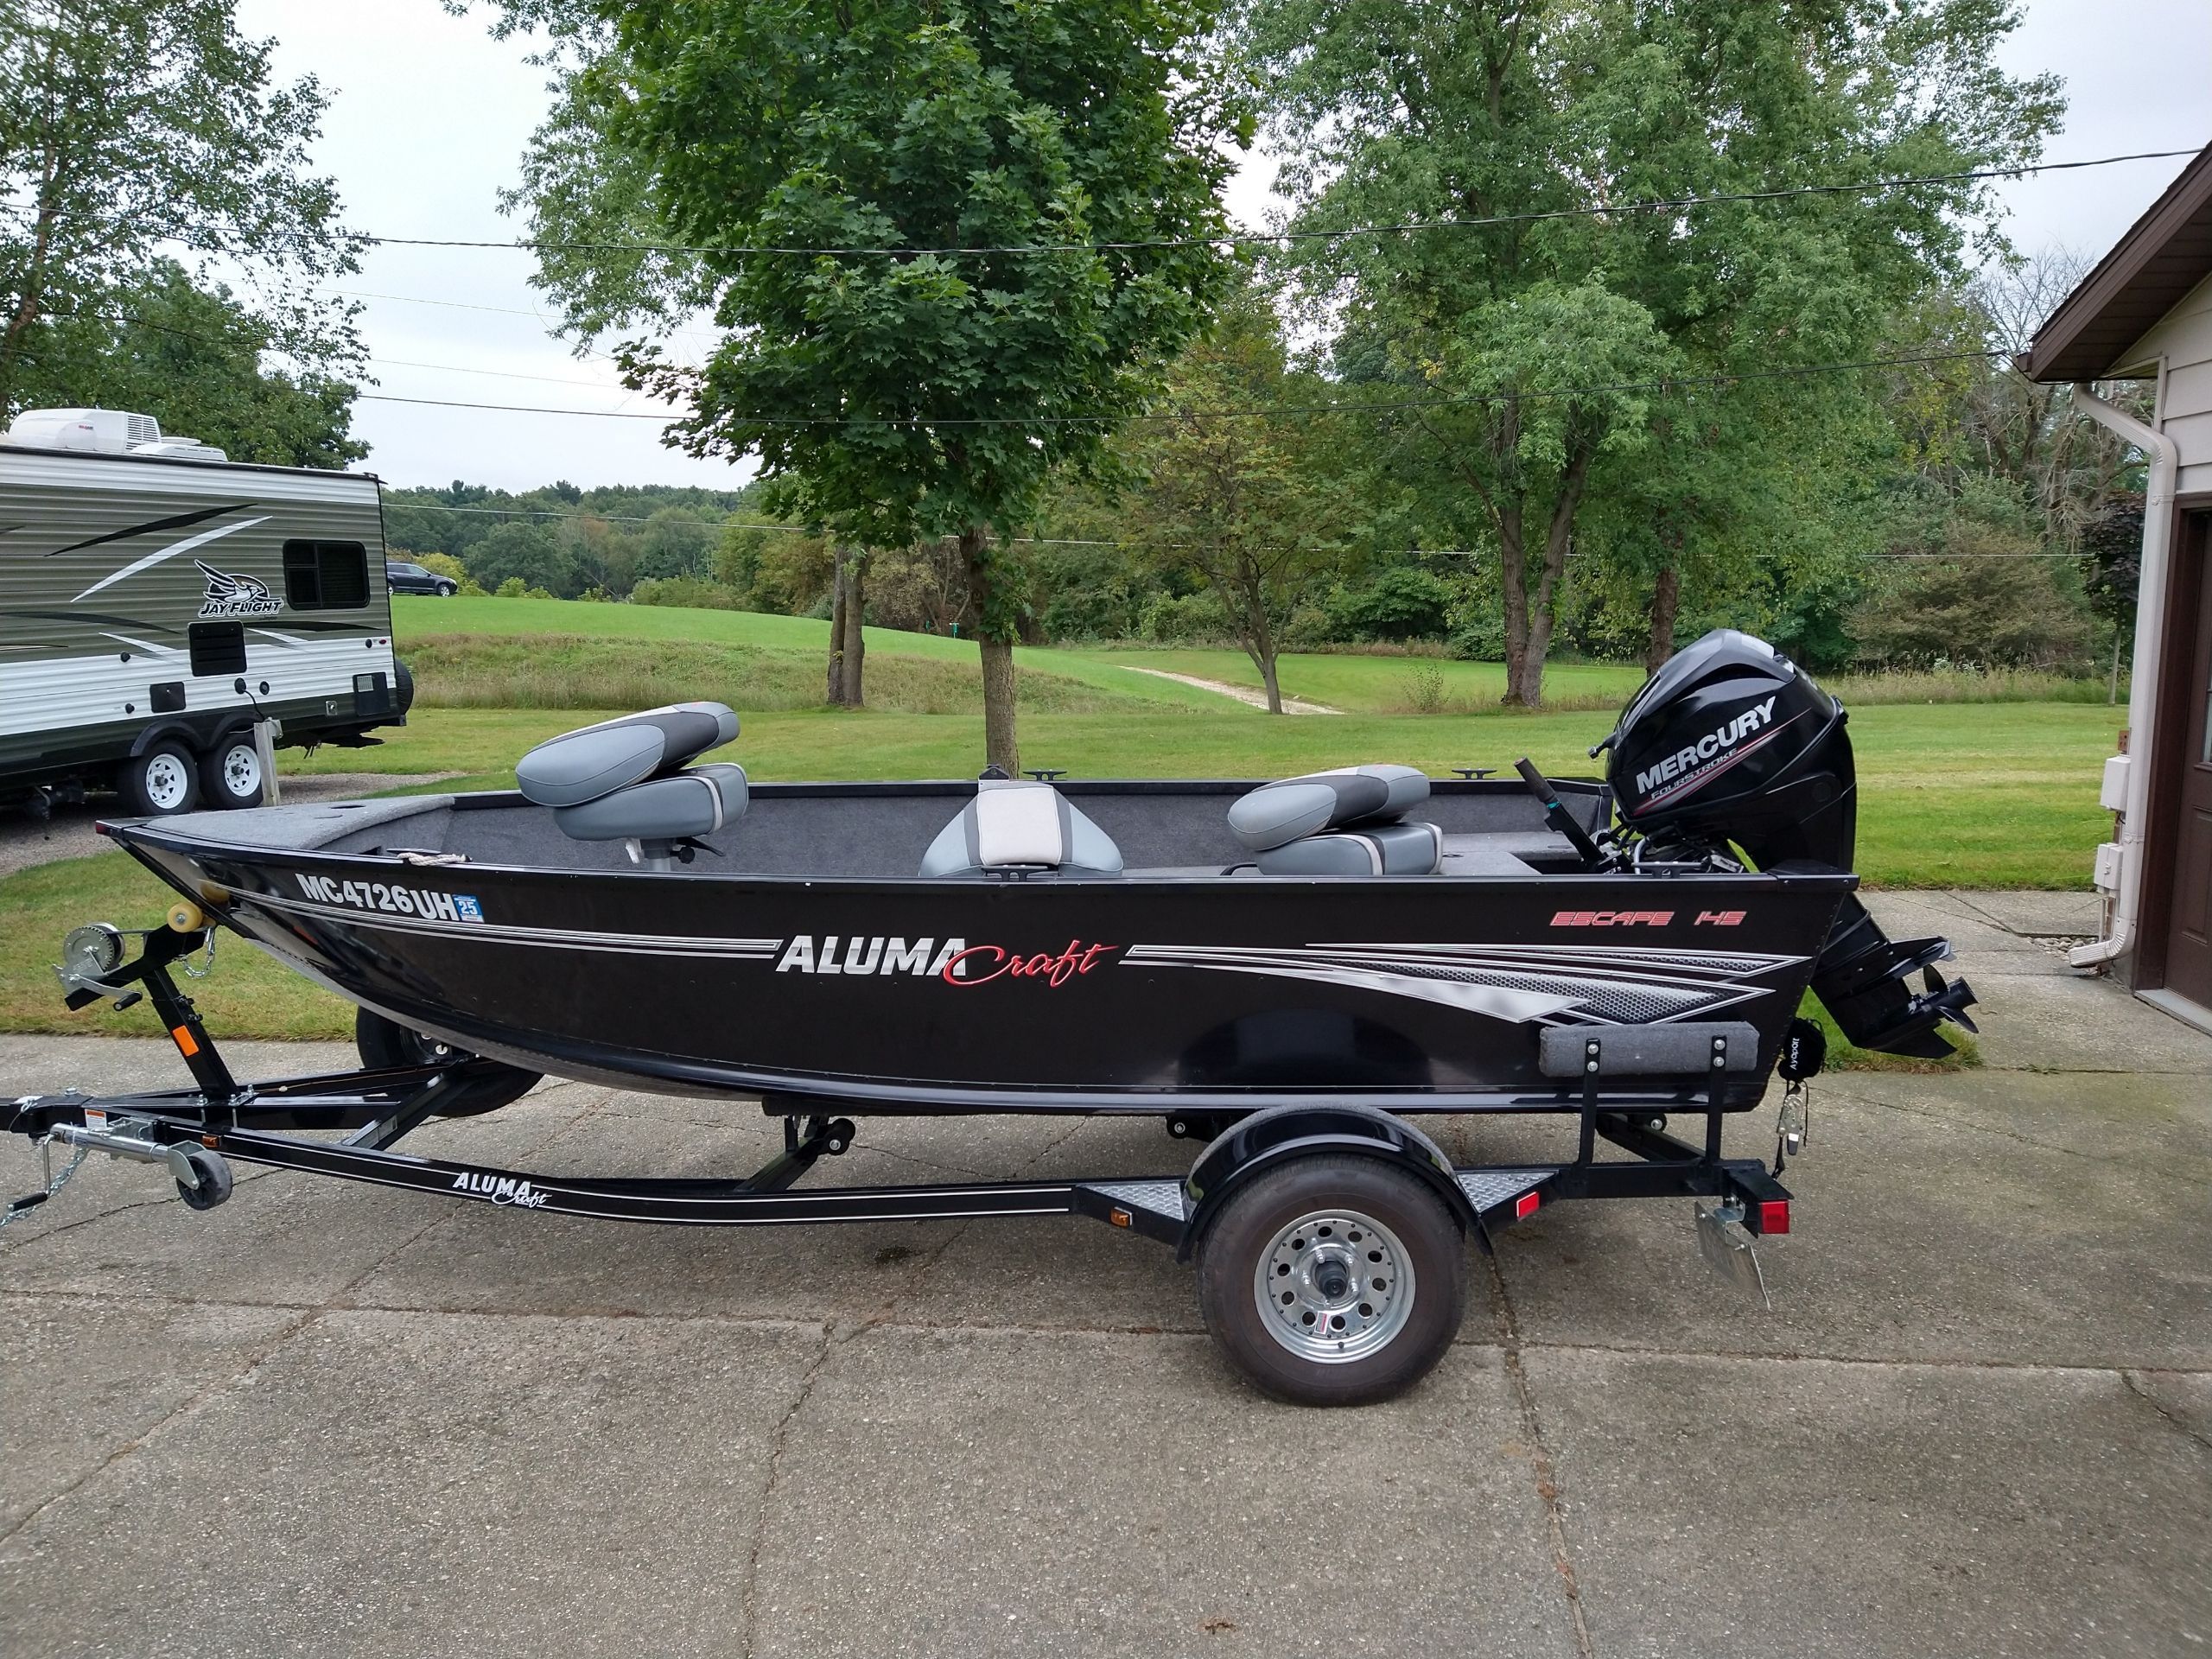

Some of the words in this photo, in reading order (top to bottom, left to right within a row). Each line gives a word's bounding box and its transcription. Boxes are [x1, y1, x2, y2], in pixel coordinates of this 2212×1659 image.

[199, 601, 227, 616] JAY
[229, 601, 283, 614] FLIGHT
[1636, 696, 1776, 794] MERCURY
[1650, 747, 1738, 801] FOURSTROKE
[458, 900, 479, 915] 25
[1549, 911, 1675, 926] ESCAPE
[1694, 910, 1747, 926] 145
[775, 935, 966, 976] ALUMA
[943, 939, 1119, 987] Craft
[1789, 1037, 1800, 1071] Ayaport
[452, 1172, 531, 1197] ALUMA
[490, 1191, 553, 1208] Craft
